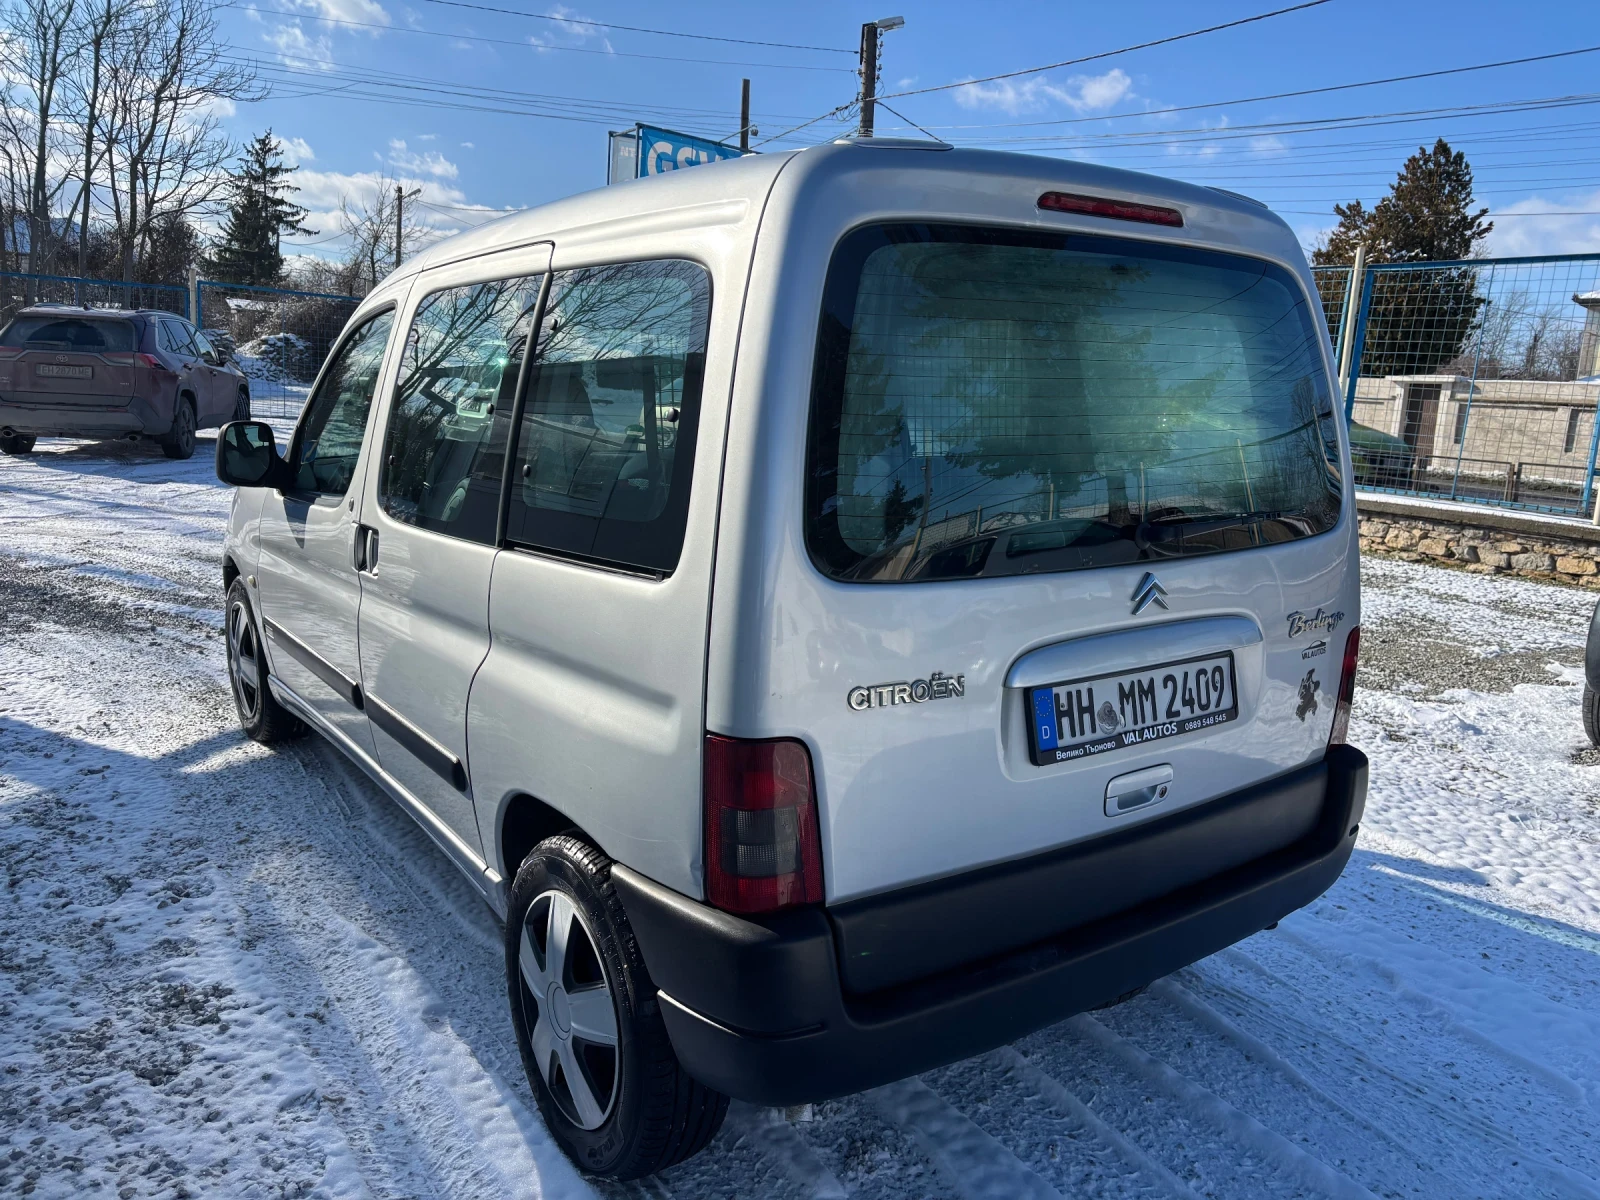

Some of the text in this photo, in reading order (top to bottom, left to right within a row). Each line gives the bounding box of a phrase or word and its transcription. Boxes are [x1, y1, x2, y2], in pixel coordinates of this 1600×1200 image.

[1287, 608, 1345, 638] Berlingo
[847, 671, 965, 711] CITROËN
[1054, 665, 1225, 740] HH MM 2409
[1041, 725, 1050, 740] D
[1122, 722, 1178, 745] VAL AUTOS
[1185, 719, 1201, 731] 0889
[1056, 740, 1116, 760] Велико Търново
